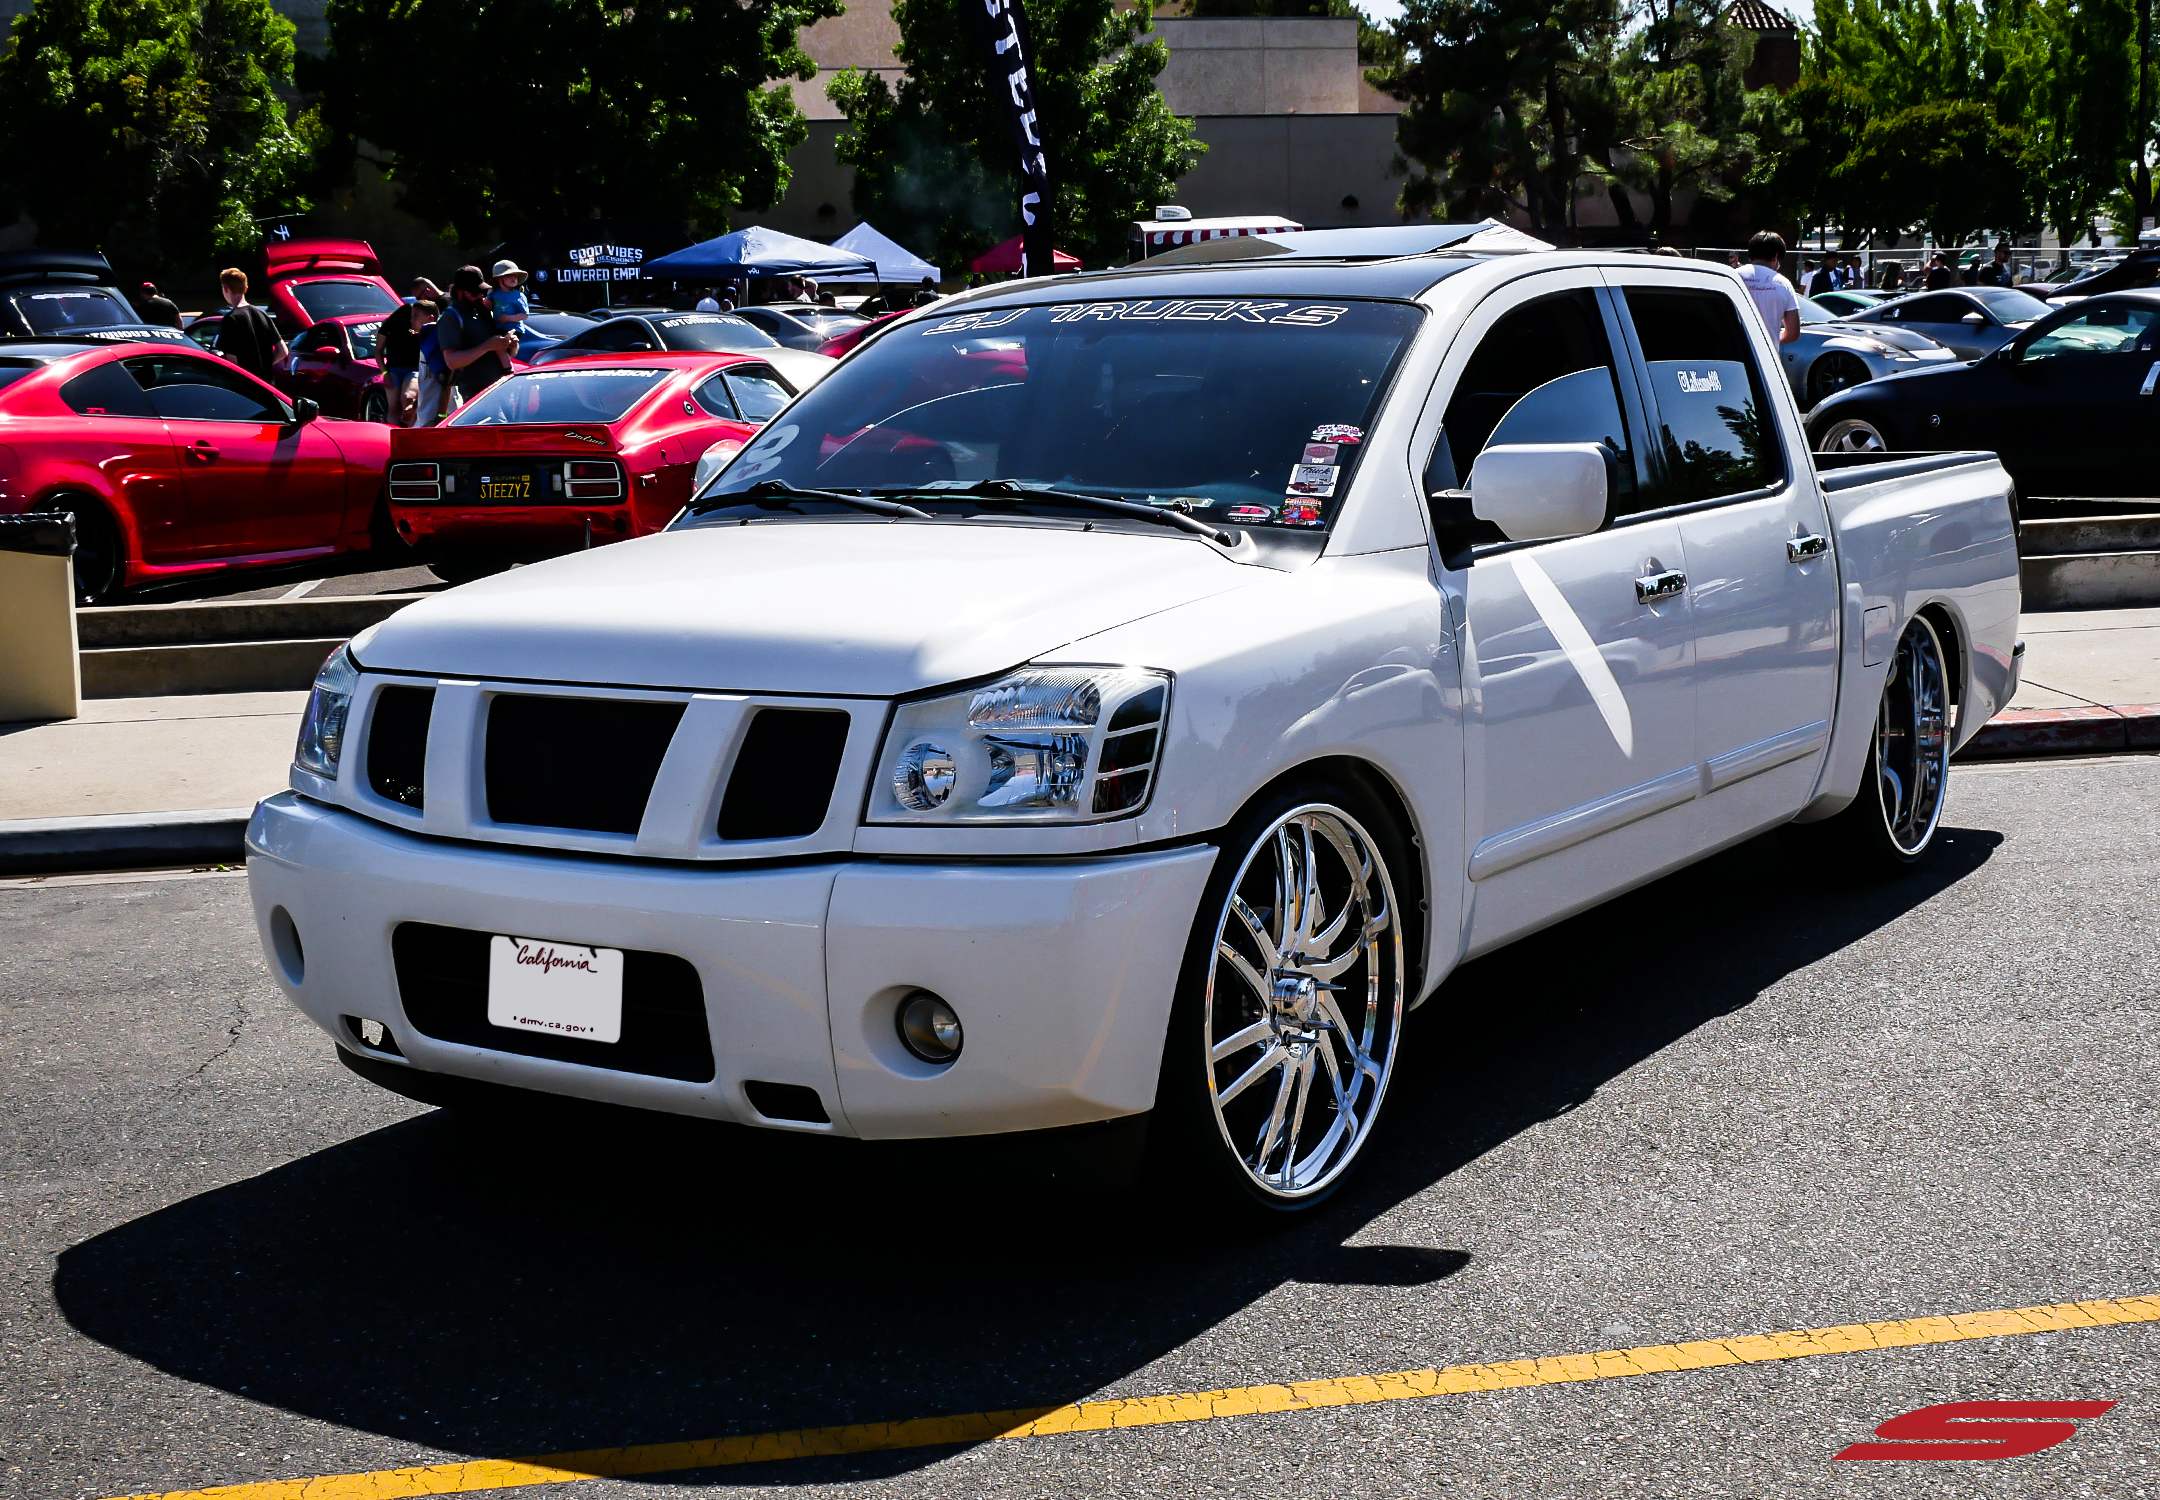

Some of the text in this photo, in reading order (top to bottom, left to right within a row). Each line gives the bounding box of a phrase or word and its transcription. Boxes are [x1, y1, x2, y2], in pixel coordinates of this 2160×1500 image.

[569, 245, 643, 260] GOOD VIBES
[579, 254, 635, 266] BAD DECISIONS
[557, 267, 641, 283] LOWERED EMPI
[660, 317, 721, 329] NOTORIOUS
[921, 299, 1350, 336] SJ TRUCKS
[560, 369, 659, 378] SUSPENSION
[564, 431, 607, 446] Datsun
[1302, 466, 1331, 475] Truck
[480, 482, 521, 499] STEEZY
[516, 944, 598, 975] California
[519, 1017, 587, 1033] dmv.ca.gov
